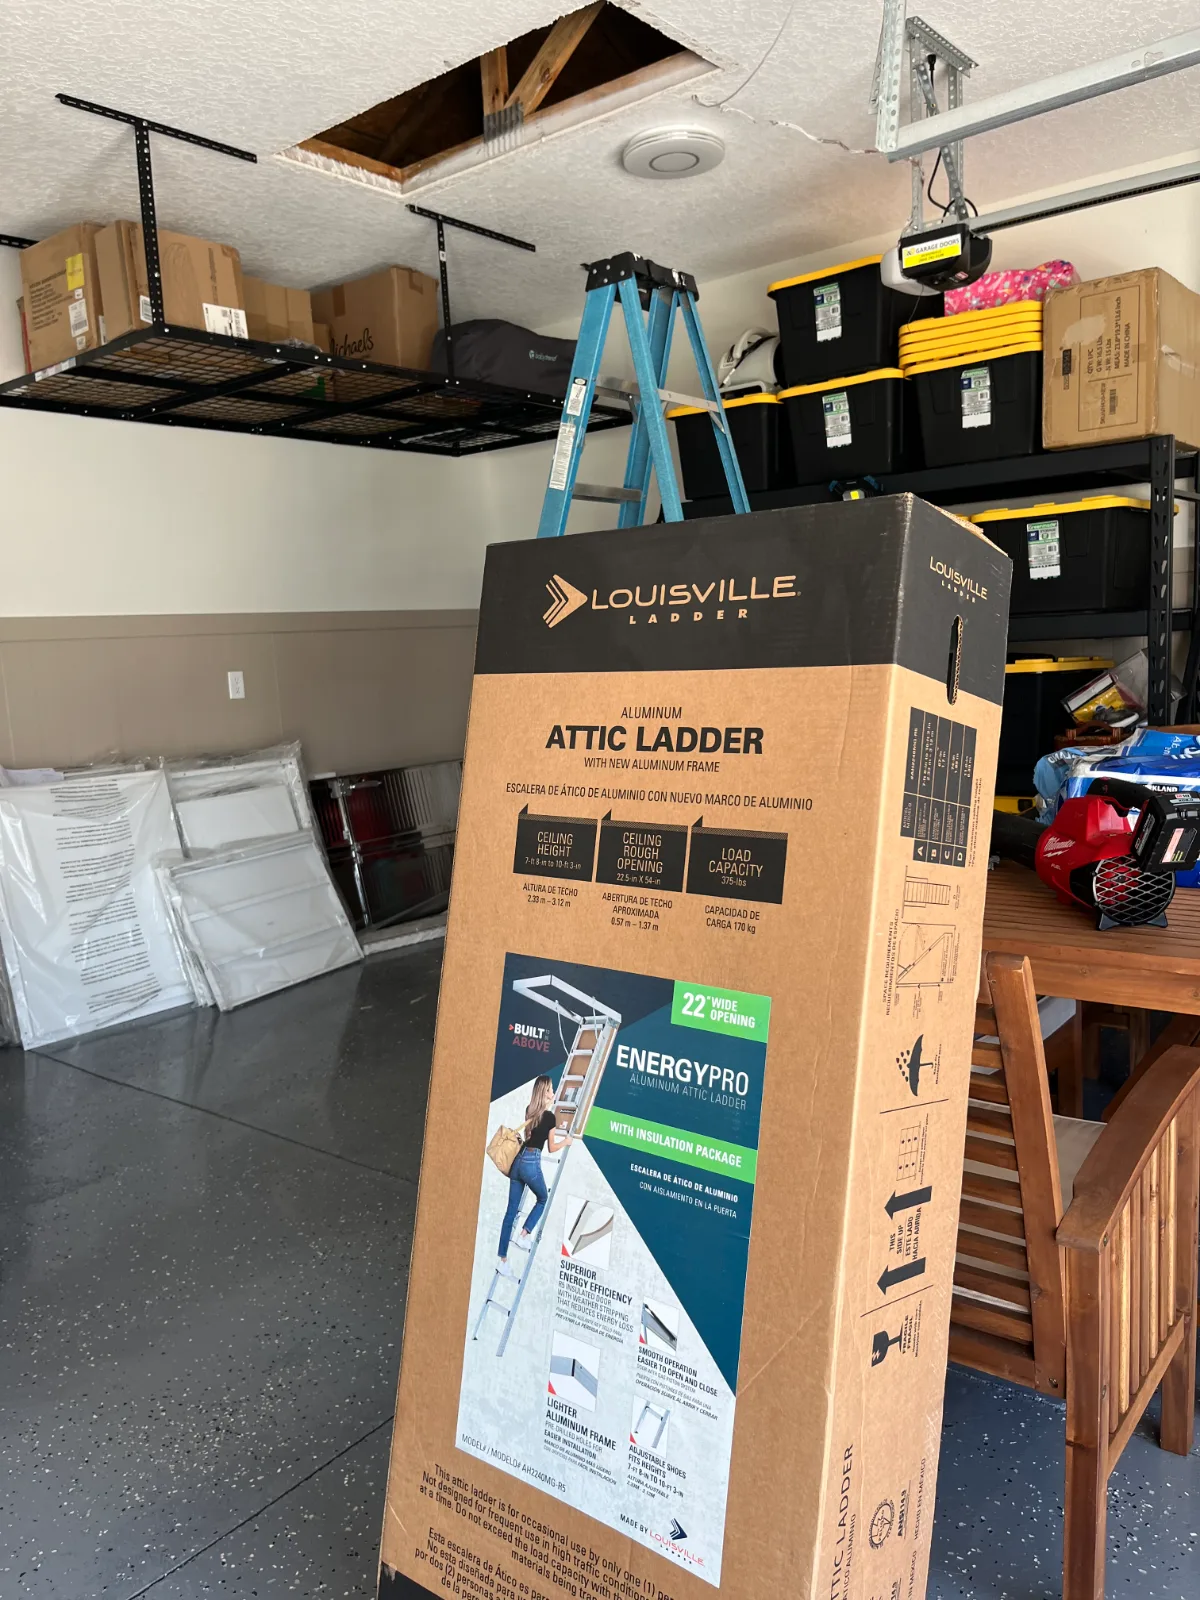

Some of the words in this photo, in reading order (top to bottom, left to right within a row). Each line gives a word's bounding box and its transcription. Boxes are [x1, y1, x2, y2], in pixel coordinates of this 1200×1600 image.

[916, 243, 938, 254] GARAGE
[939, 237, 960, 248] DOORS
[930, 555, 988, 600] LOUISVILLE
[591, 575, 797, 610] LOUISVILLE
[628, 607, 749, 625] LADDER
[619, 706, 683, 719] ALUMINUM
[544, 724, 628, 751] ATTIC
[634, 725, 765, 755] LADDER
[582, 756, 608, 769] WITH
[608, 757, 631, 770] NEW
[631, 758, 685, 772] ALUMINUM
[685, 759, 720, 773] FRAME
[505, 782, 546, 796] ESCALERA
[547, 784, 560, 797] DE
[559, 782, 586, 798] ÁTICO
[586, 786, 600, 799] DE
[600, 786, 645, 801] ALUMINIO
[646, 789, 668, 803] CON
[668, 790, 702, 805] NUEVO
[704, 791, 741, 807] MARCO
[742, 793, 758, 808] DE
[758, 794, 813, 811] ALUMINIO
[536, 830, 574, 846] CEILING
[621, 831, 662, 847] CEILING
[536, 842, 572, 858] HEIGHT
[622, 844, 659, 860] ROUGH
[720, 846, 751, 862] LOAD
[523, 856, 535, 865] 7-ft
[535, 857, 547, 867] 8-in
[547, 858, 554, 867] to
[554, 859, 569, 869] 10-ft
[569, 860, 582, 870] 3-in
[616, 857, 663, 874] OPENING
[707, 860, 764, 878] CAPACITY
[521, 881, 546, 893] ALTURA
[547, 884, 556, 894] DE
[556, 886, 578, 897] TECHO
[615, 872, 638, 883] 22.5-in
[637, 874, 644, 884] X
[643, 875, 661, 886] 54-in
[720, 875, 747, 887] 375-lbs
[526, 894, 540, 904] 2.33
[539, 895, 546, 905] m
[551, 897, 564, 907] 3.12
[564, 898, 571, 908] m
[600, 891, 638, 905] ABERTURA
[638, 895, 648, 906] DE
[649, 897, 673, 909] TECHO
[611, 904, 660, 920] APROXIMADA
[703, 904, 748, 919] CAPACIDAD
[748, 910, 760, 921] DE
[610, 916, 624, 927] 0.57
[623, 918, 631, 928] m
[637, 920, 651, 931] 1.37
[651, 921, 659, 932] m
[705, 917, 732, 931] CARGA
[733, 920, 746, 932] 170
[746, 922, 756, 935] kg
[710, 996, 738, 1013] WIDE
[709, 1008, 756, 1029] OPENING
[513, 1021, 545, 1041] BUILT
[511, 1033, 550, 1053] ABOVE
[615, 1043, 750, 1097] ENERGYPRO
[628, 1071, 680, 1095] ALUMINUM
[680, 1083, 708, 1102] ATTIC
[709, 1090, 747, 1112] LADDER
[609, 1119, 634, 1138] WITH
[635, 1126, 694, 1155] INSULATION
[694, 1142, 742, 1168] PACKAGE
[629, 1162, 662, 1181] ESCALERA
[662, 1172, 672, 1184] DE
[672, 1173, 693, 1190] ÁTICO
[693, 1181, 703, 1193] DE
[703, 1184, 739, 1204] ALUMINIO
[638, 1180, 652, 1193] CON
[652, 1184, 693, 1206] AISLAMIENTO
[693, 1197, 703, 1209] EN
[703, 1200, 712, 1212] LA
[712, 1202, 737, 1219] PUERTA
[898, 1225, 903, 1236] UP
[914, 1207, 922, 1234] ARRIBA
[559, 1258, 597, 1281] SUPERIOR
[558, 1269, 589, 1290] ENERGY
[589, 1280, 633, 1307] EFFICIENCY
[637, 1345, 664, 1364] SMOOTH
[663, 1355, 698, 1378] OPERATION
[636, 1354, 658, 1371] EASIER
[658, 1363, 667, 1374] TO
[666, 1367, 684, 1381] OPEN
[683, 1375, 698, 1388] AND
[698, 1381, 718, 1397] CLOSE
[546, 1395, 577, 1419] LIGHTER
[545, 1407, 588, 1437] ALUMINUM
[589, 1428, 617, 1451] FRAME
[461, 1431, 487, 1453] MODEL#
[543, 1427, 562, 1443] EASIER
[561, 1436, 597, 1460] INSTALLATION
[627, 1452, 641, 1467] FITS
[641, 1459, 666, 1479] HEIGHTS
[628, 1443, 666, 1469] ADJUSTABLE
[666, 1461, 687, 1479] SHOES
[836, 1444, 853, 1545] LADDER
[917, 1495, 923, 1509] EN
[422, 1469, 437, 1488] Not
[437, 1477, 472, 1510] designed
[473, 1497, 486, 1516] for
[487, 1505, 524, 1538] frequent
[523, 1528, 540, 1545] use
[541, 1536, 550, 1551] in
[551, 1541, 572, 1566] high
[572, 1553, 600, 1580] traffic
[433, 1462, 450, 1482] This
[451, 1472, 469, 1492] attic
[470, 1482, 497, 1508] ladder
[497, 1497, 506, 1513] is
[506, 1502, 520, 1521] for
[520, 1510, 568, 1548] occasional
[569, 1539, 586, 1558] use
[587, 1547, 599, 1567] by
[600, 1554, 622, 1580] only
[622, 1568, 641, 1589] one
[642, 1577, 655, 1598] (1)
[914, 1509, 922, 1541] HECHO
[619, 1513, 638, 1530] MADE
[638, 1523, 648, 1535] BY
[648, 1529, 705, 1567] LOUISVILLE
[845, 1513, 857, 1568] ALUMINIO
